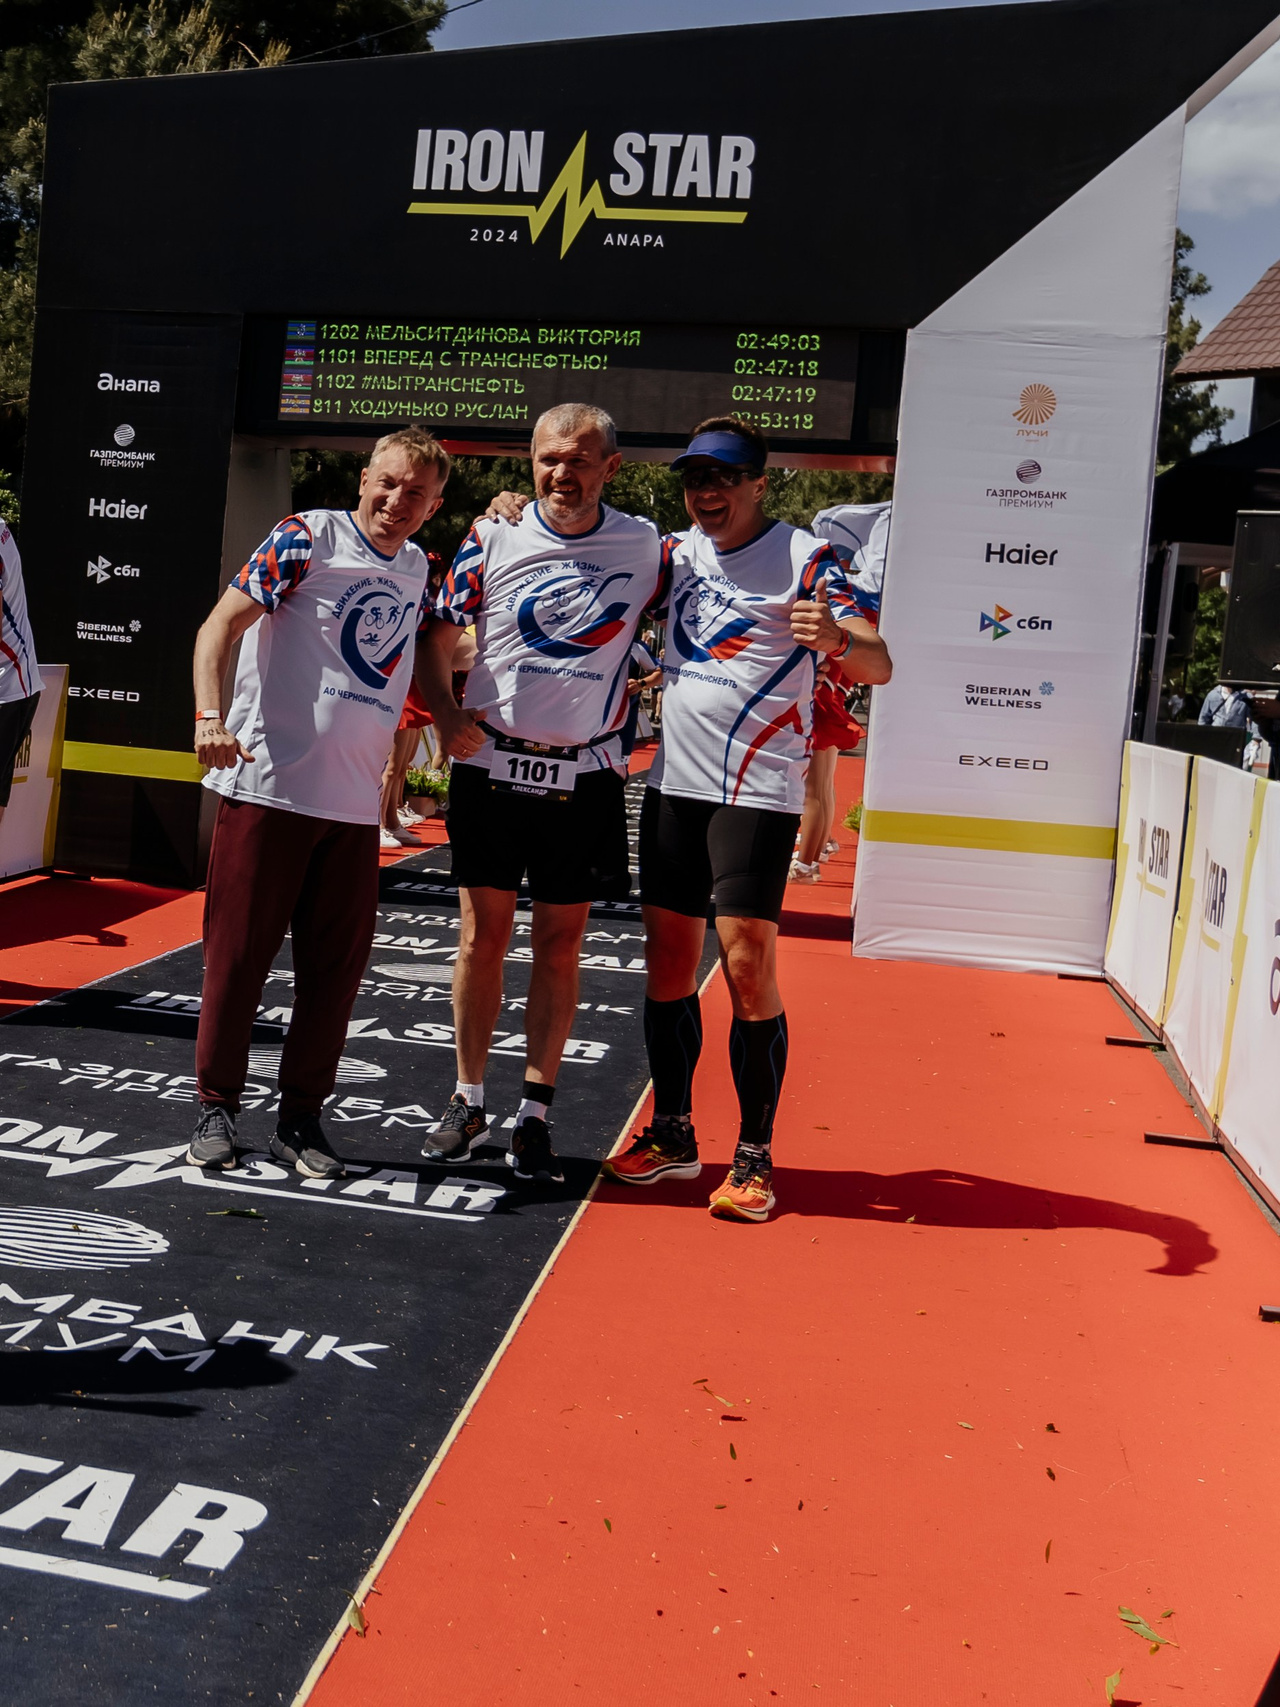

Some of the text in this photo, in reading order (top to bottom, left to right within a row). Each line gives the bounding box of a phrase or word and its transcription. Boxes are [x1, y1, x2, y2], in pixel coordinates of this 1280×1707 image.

[413, 129, 756, 199] IRON STAR
[470, 228, 664, 247] 2024 ANAPA
[320, 324, 820, 351] 1202 МЕЛЬСИТДИНОВА ВИКТОРИЯ 02:49:03
[318, 349, 818, 376] 1101 ВПЕРЕД С ТРАНСНЕФТЬЮ! 02:47:18
[316, 374, 816, 403] 1102 #МЫТРАНСНЕФТЬ 02:47:19
[312, 399, 341, 414] 811
[349, 400, 448, 419] ХОДУНЬКО
[454, 403, 528, 420] РУСЛАН
[1016, 429, 1048, 438] ЛУЧИ
[90, 449, 156, 461] ГАЗПРОМБАНК
[100, 459, 144, 468] ПРЕМИУМ
[986, 488, 1067, 500] ГАЗПРОМБАНК
[999, 499, 1053, 509] ПРЕМИУМ
[88, 498, 148, 520] Haier
[985, 542, 1058, 566] Haier
[113, 564, 140, 577] сбп
[332, 577, 373, 620] ДВИЖЕНИЕ
[505, 565, 553, 612] ДВИЖЕНИЕ
[1016, 616, 1052, 631] сбп
[660, 665, 738, 689] ЕРНОМОРТРАНСНЕФТЬ
[68, 686, 140, 702] EXEED
[323, 686, 335, 696] АО
[507, 757, 560, 785] 1101
[959, 754, 1049, 771] EXEED
[511, 785, 548, 796] АЛЕКСАНДР
[1148, 825, 1170, 880] STAR
